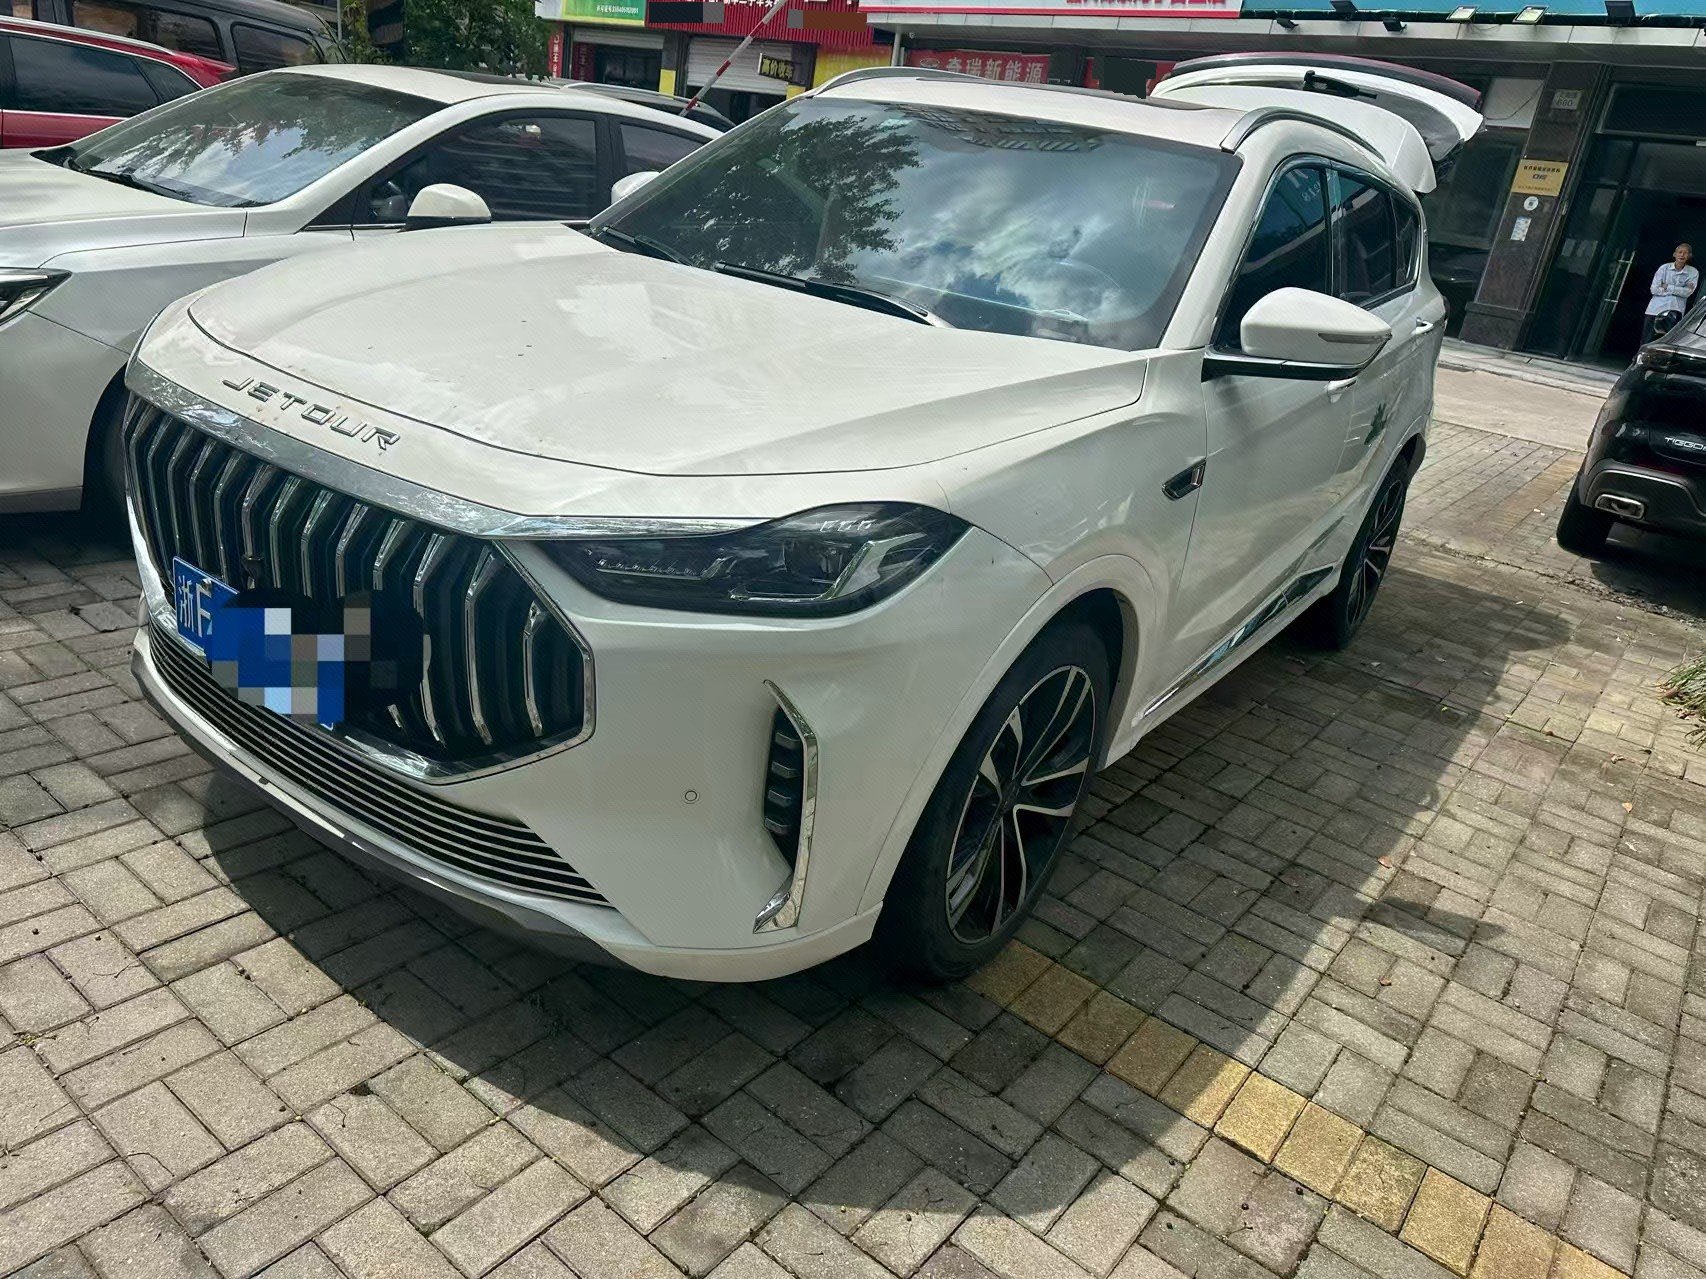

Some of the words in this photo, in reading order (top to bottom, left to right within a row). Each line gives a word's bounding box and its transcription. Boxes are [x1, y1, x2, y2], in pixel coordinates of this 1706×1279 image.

[946, 57, 1044, 83] 奇瑞新能源
[222, 376, 401, 451] JETOUR
